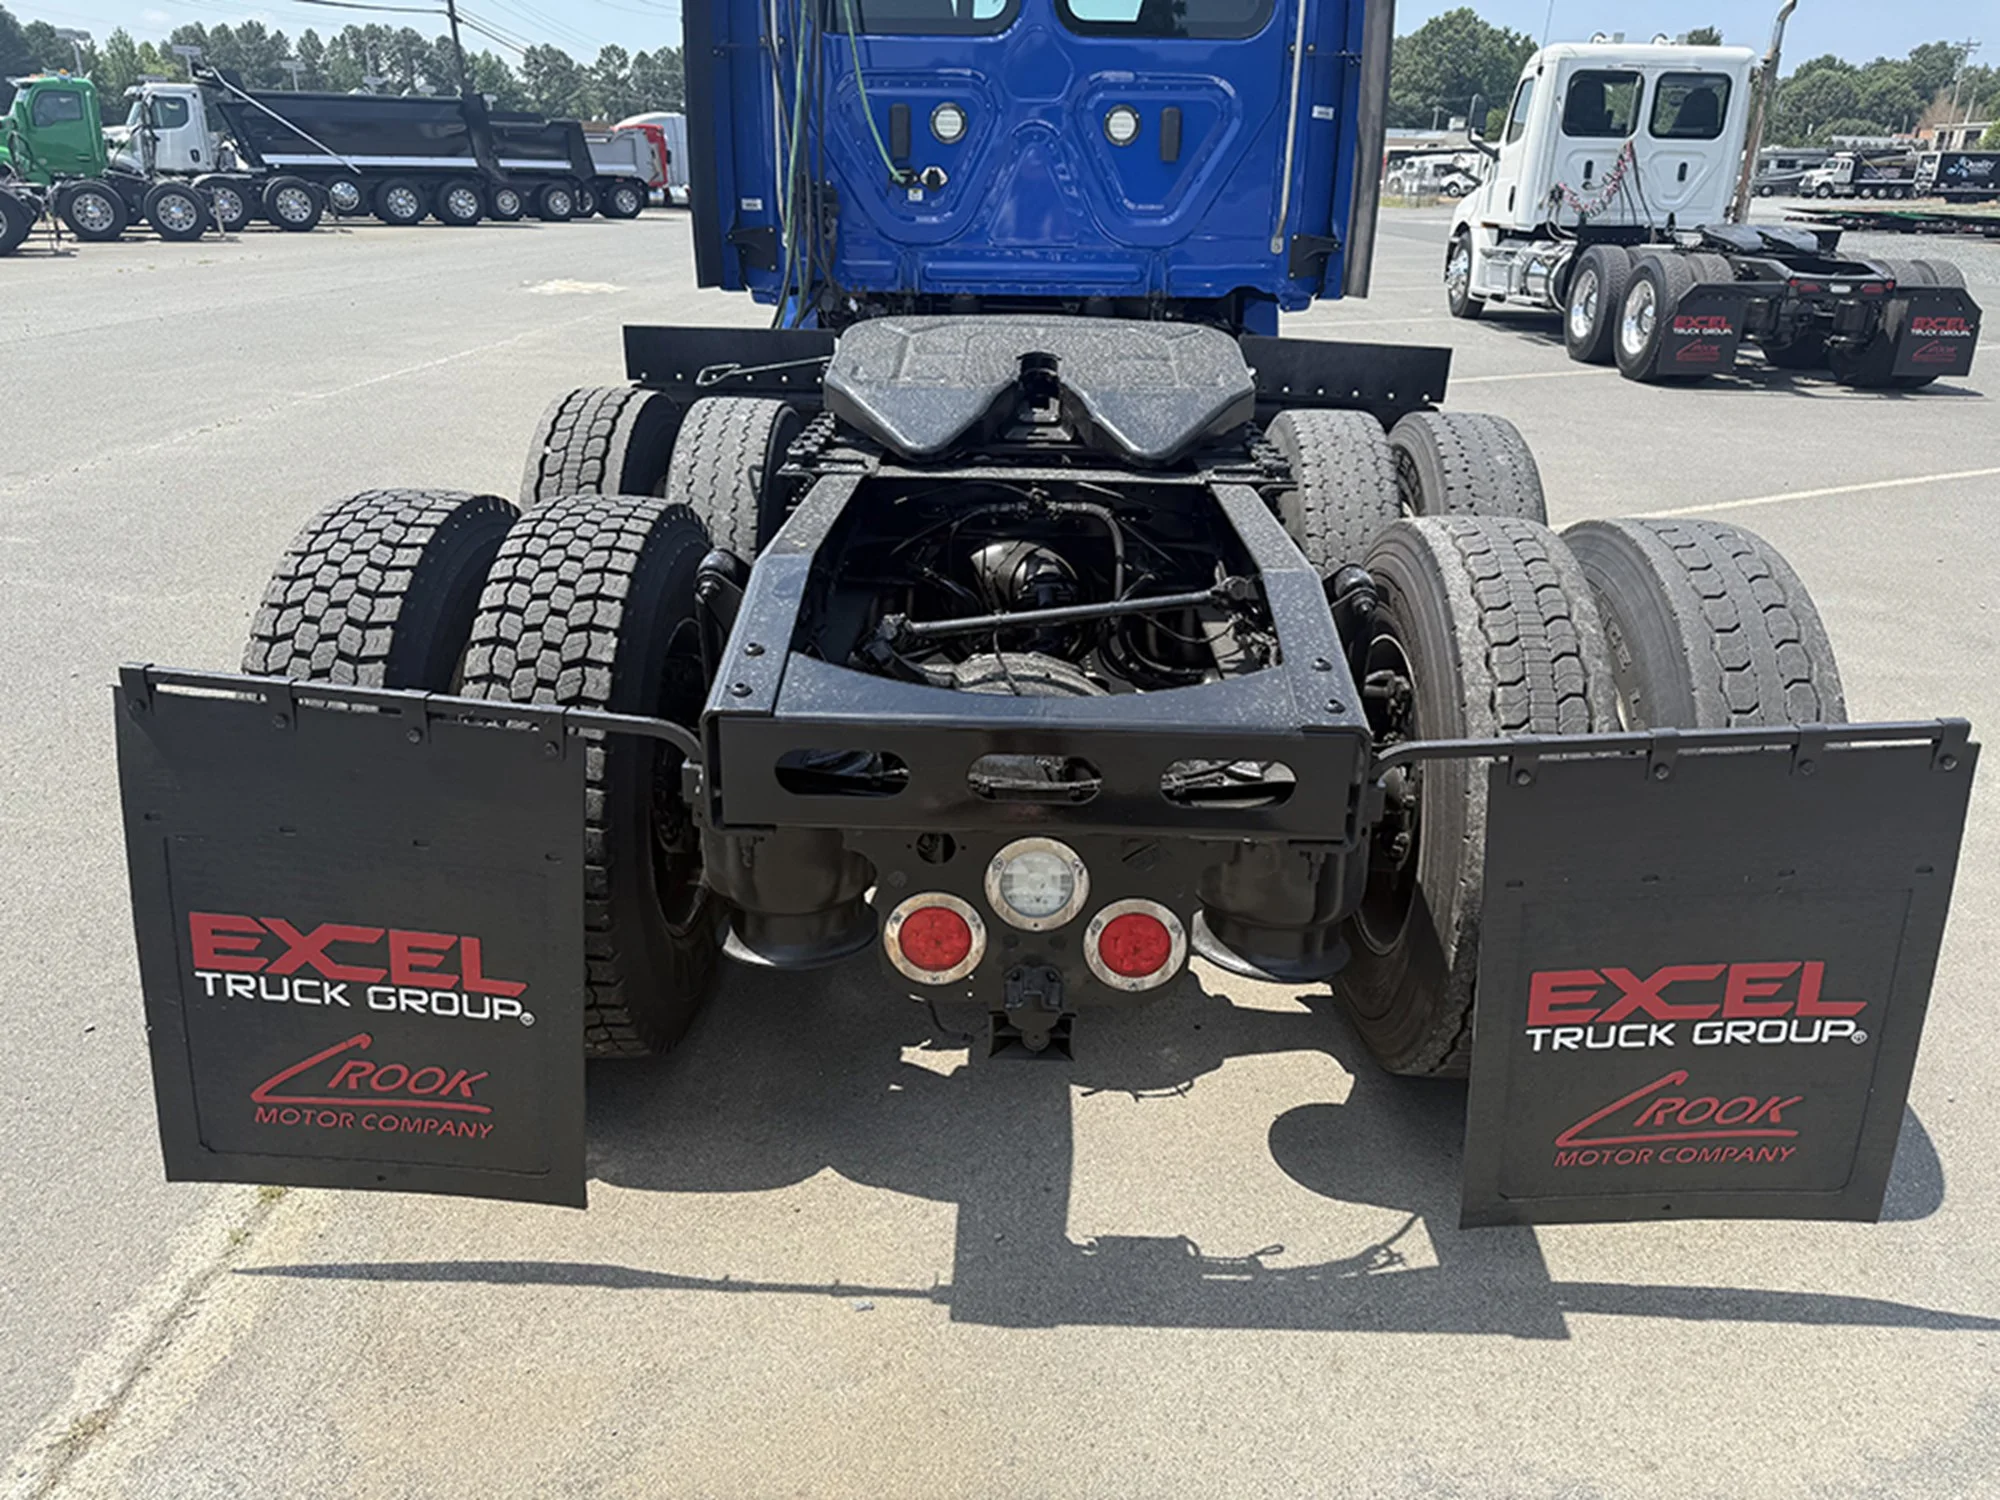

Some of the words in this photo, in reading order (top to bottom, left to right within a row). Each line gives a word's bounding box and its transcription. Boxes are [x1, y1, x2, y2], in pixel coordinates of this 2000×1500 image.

[189, 911, 528, 997] EXCEL
[194, 971, 351, 1008] TRUCK
[1527, 961, 1868, 1025] EXCEL
[1525, 1022, 1676, 1052] TRUCK
[254, 1106, 356, 1129] MOTOR
[361, 1112, 494, 1139] COMPANY
[1553, 1147, 1653, 1167] MOTOR
[1658, 1145, 1797, 1164] COMPANY
